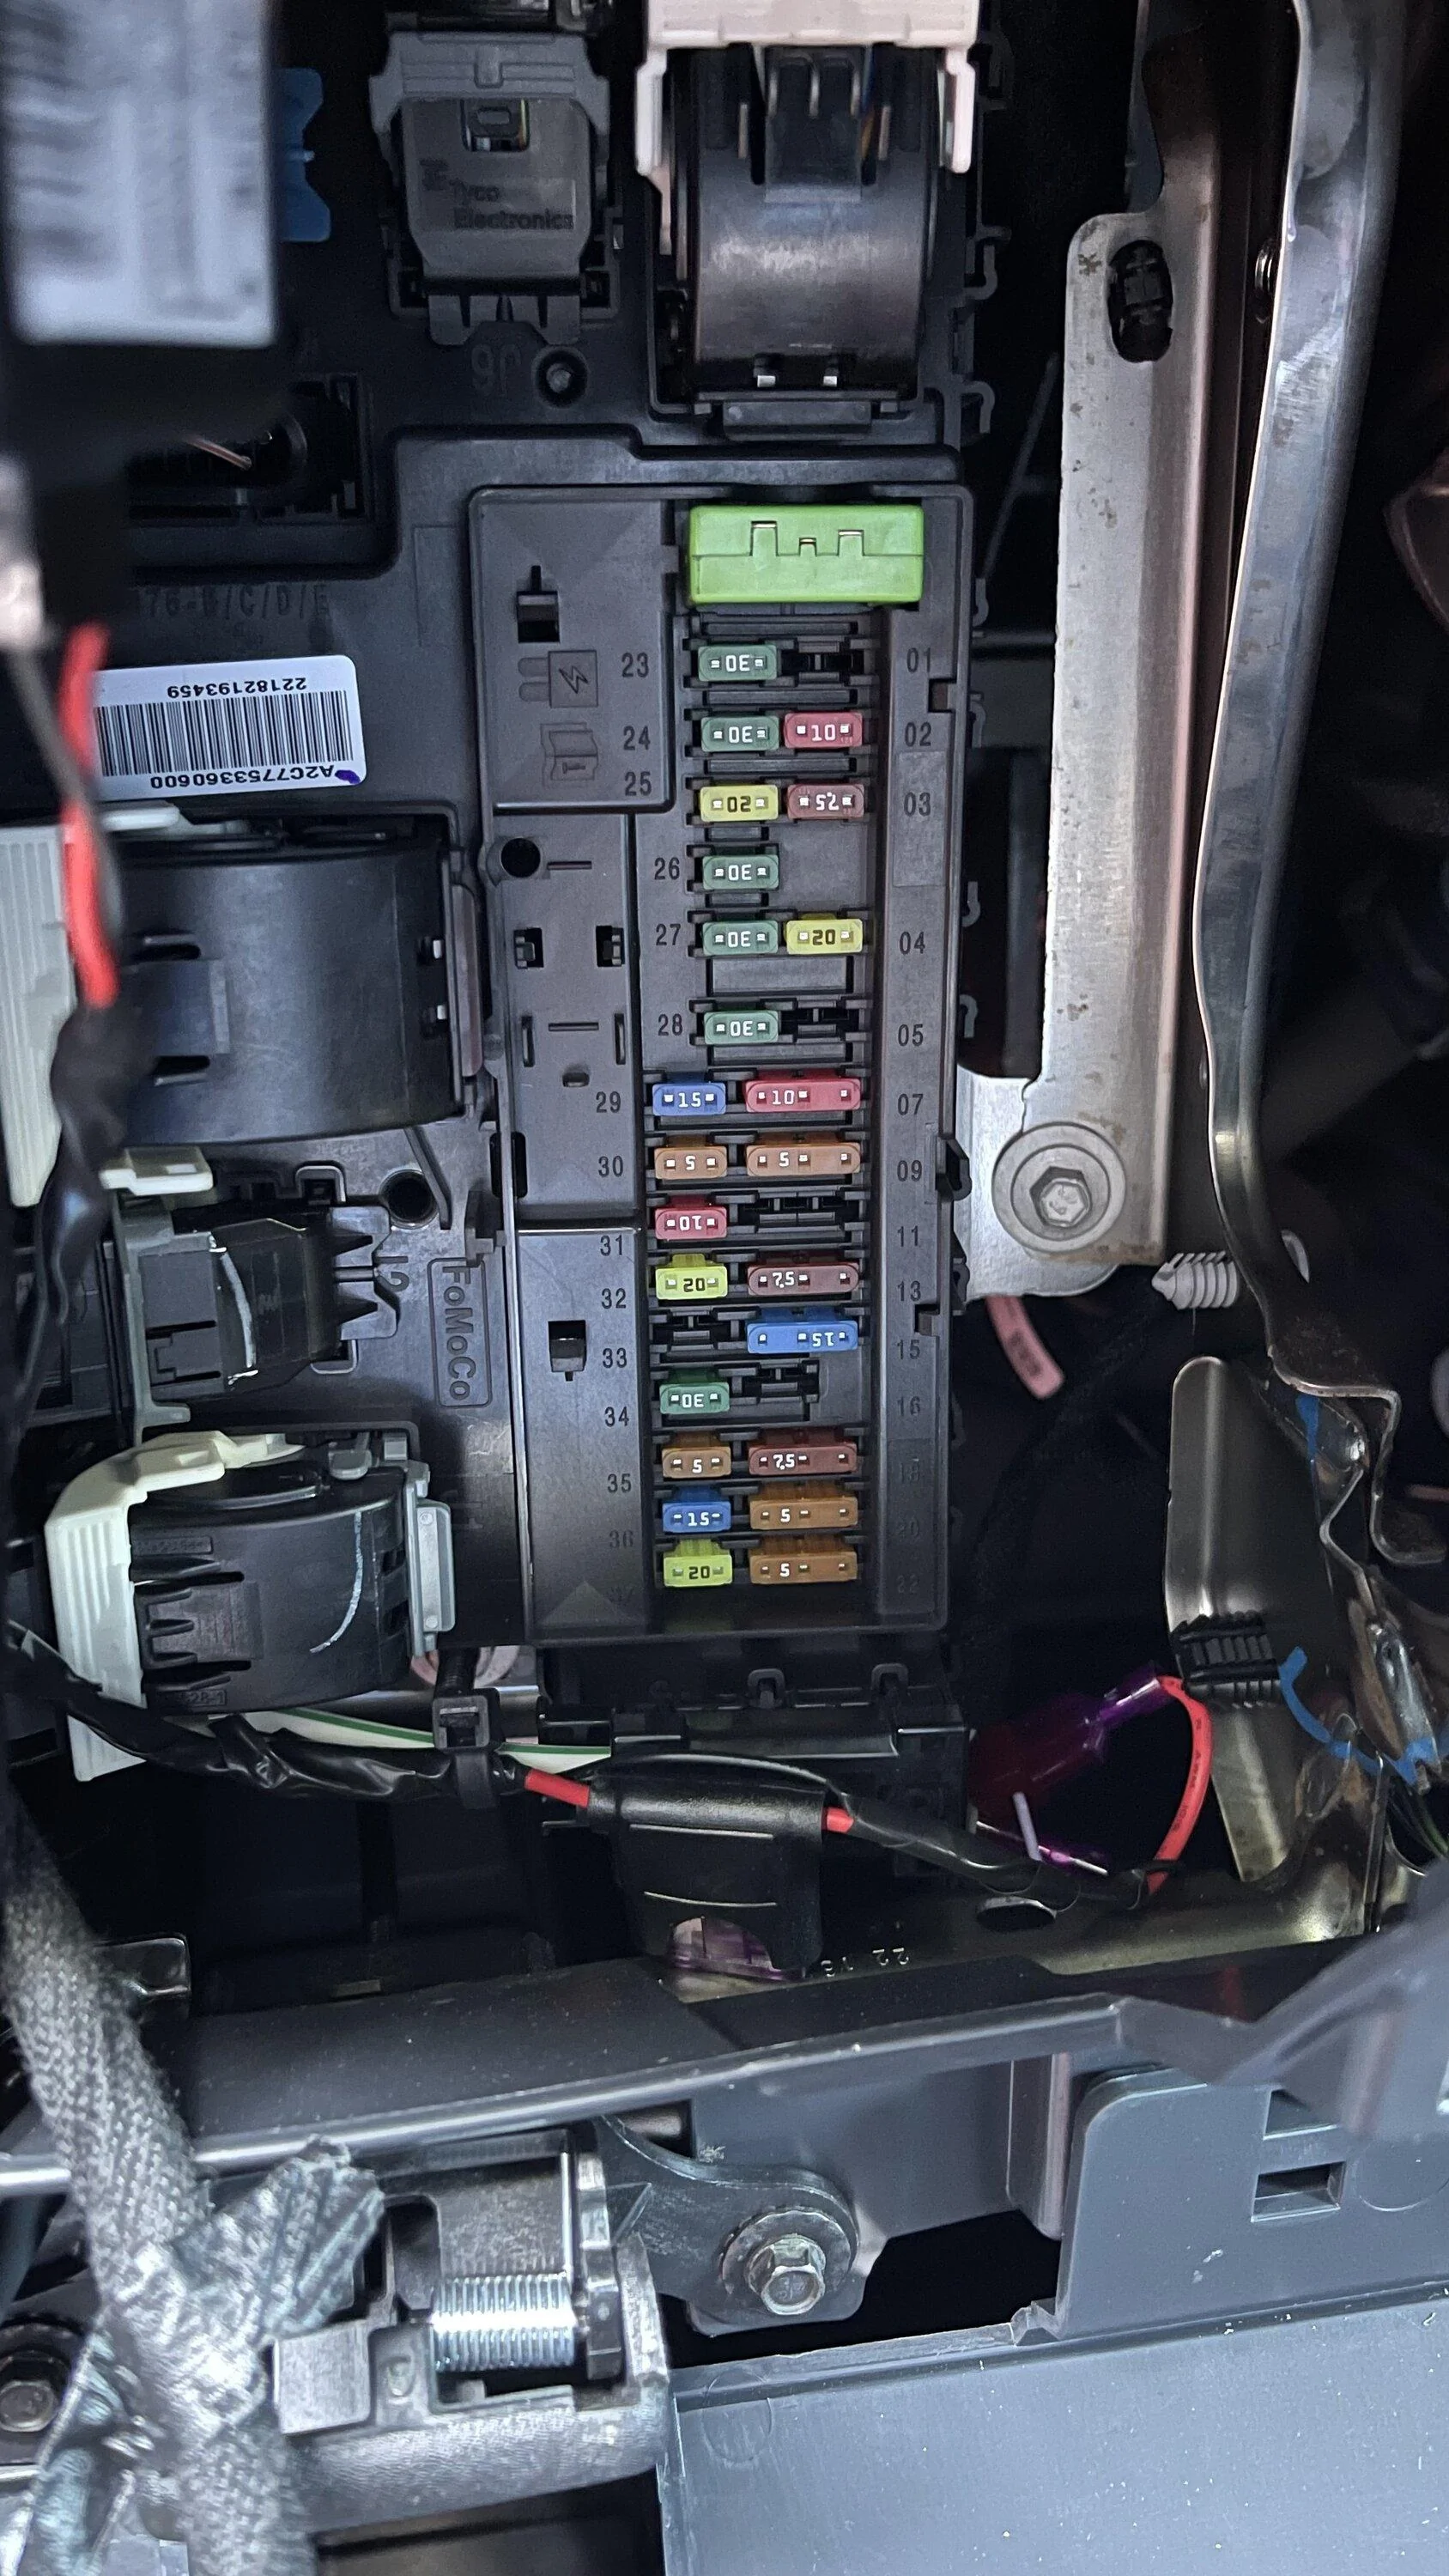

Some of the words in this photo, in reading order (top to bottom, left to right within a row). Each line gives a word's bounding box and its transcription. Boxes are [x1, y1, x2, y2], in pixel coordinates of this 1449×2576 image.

[449, 178, 500, 209] Tyco
[454, 209, 575, 230] Electronics
[621, 653, 650, 678] 23
[724, 654, 751, 672] 30
[906, 647, 931, 673] 01
[167, 677, 306, 699] 22182193459
[623, 726, 651, 750] 24
[728, 726, 754, 744] 30
[810, 724, 836, 742] 10
[904, 722, 932, 747] 02
[150, 764, 335, 789] A2C7753360600
[624, 772, 652, 797] 25
[726, 795, 752, 813] 20
[903, 792, 931, 817] 03
[653, 857, 681, 881] 26
[727, 864, 753, 882] 30
[655, 923, 682, 946] 27
[727, 930, 752, 947] 30
[811, 928, 837, 945] 20
[898, 931, 926, 954] 04
[657, 1013, 683, 1036] 28
[729, 1020, 754, 1037] 30
[897, 1024, 925, 1047] 05
[595, 1091, 621, 1113] 29
[676, 1091, 702, 1109] 15
[772, 1090, 795, 1106] 10
[896, 1093, 925, 1116] 07
[597, 1155, 624, 1178] 30
[685, 1155, 696, 1171] 5
[779, 1151, 790, 1168] 5
[896, 1159, 923, 1182] 09
[678, 1215, 703, 1231] 10
[599, 1235, 624, 1256] 31
[896, 1225, 919, 1248] 11
[682, 1277, 706, 1293] 20
[772, 1271, 796, 1289] 7.5
[600, 1288, 627, 1309] 32
[896, 1280, 922, 1303] 13
[441, 1266, 477, 1400] FoMoCo
[811, 1332, 835, 1347] 15
[602, 1347, 628, 1369] 33
[896, 1339, 921, 1359] 15
[682, 1393, 705, 1408] 30
[896, 1395, 921, 1417] 16
[603, 1406, 630, 1427] 34
[692, 1458, 704, 1474] 5
[773, 1454, 796, 1471] 7.5
[607, 1473, 633, 1494] 35
[687, 1511, 711, 1527] 15
[779, 1509, 791, 1523] 5
[609, 1529, 634, 1550] 36
[688, 1565, 712, 1580] 20
[779, 1563, 791, 1577] 5
